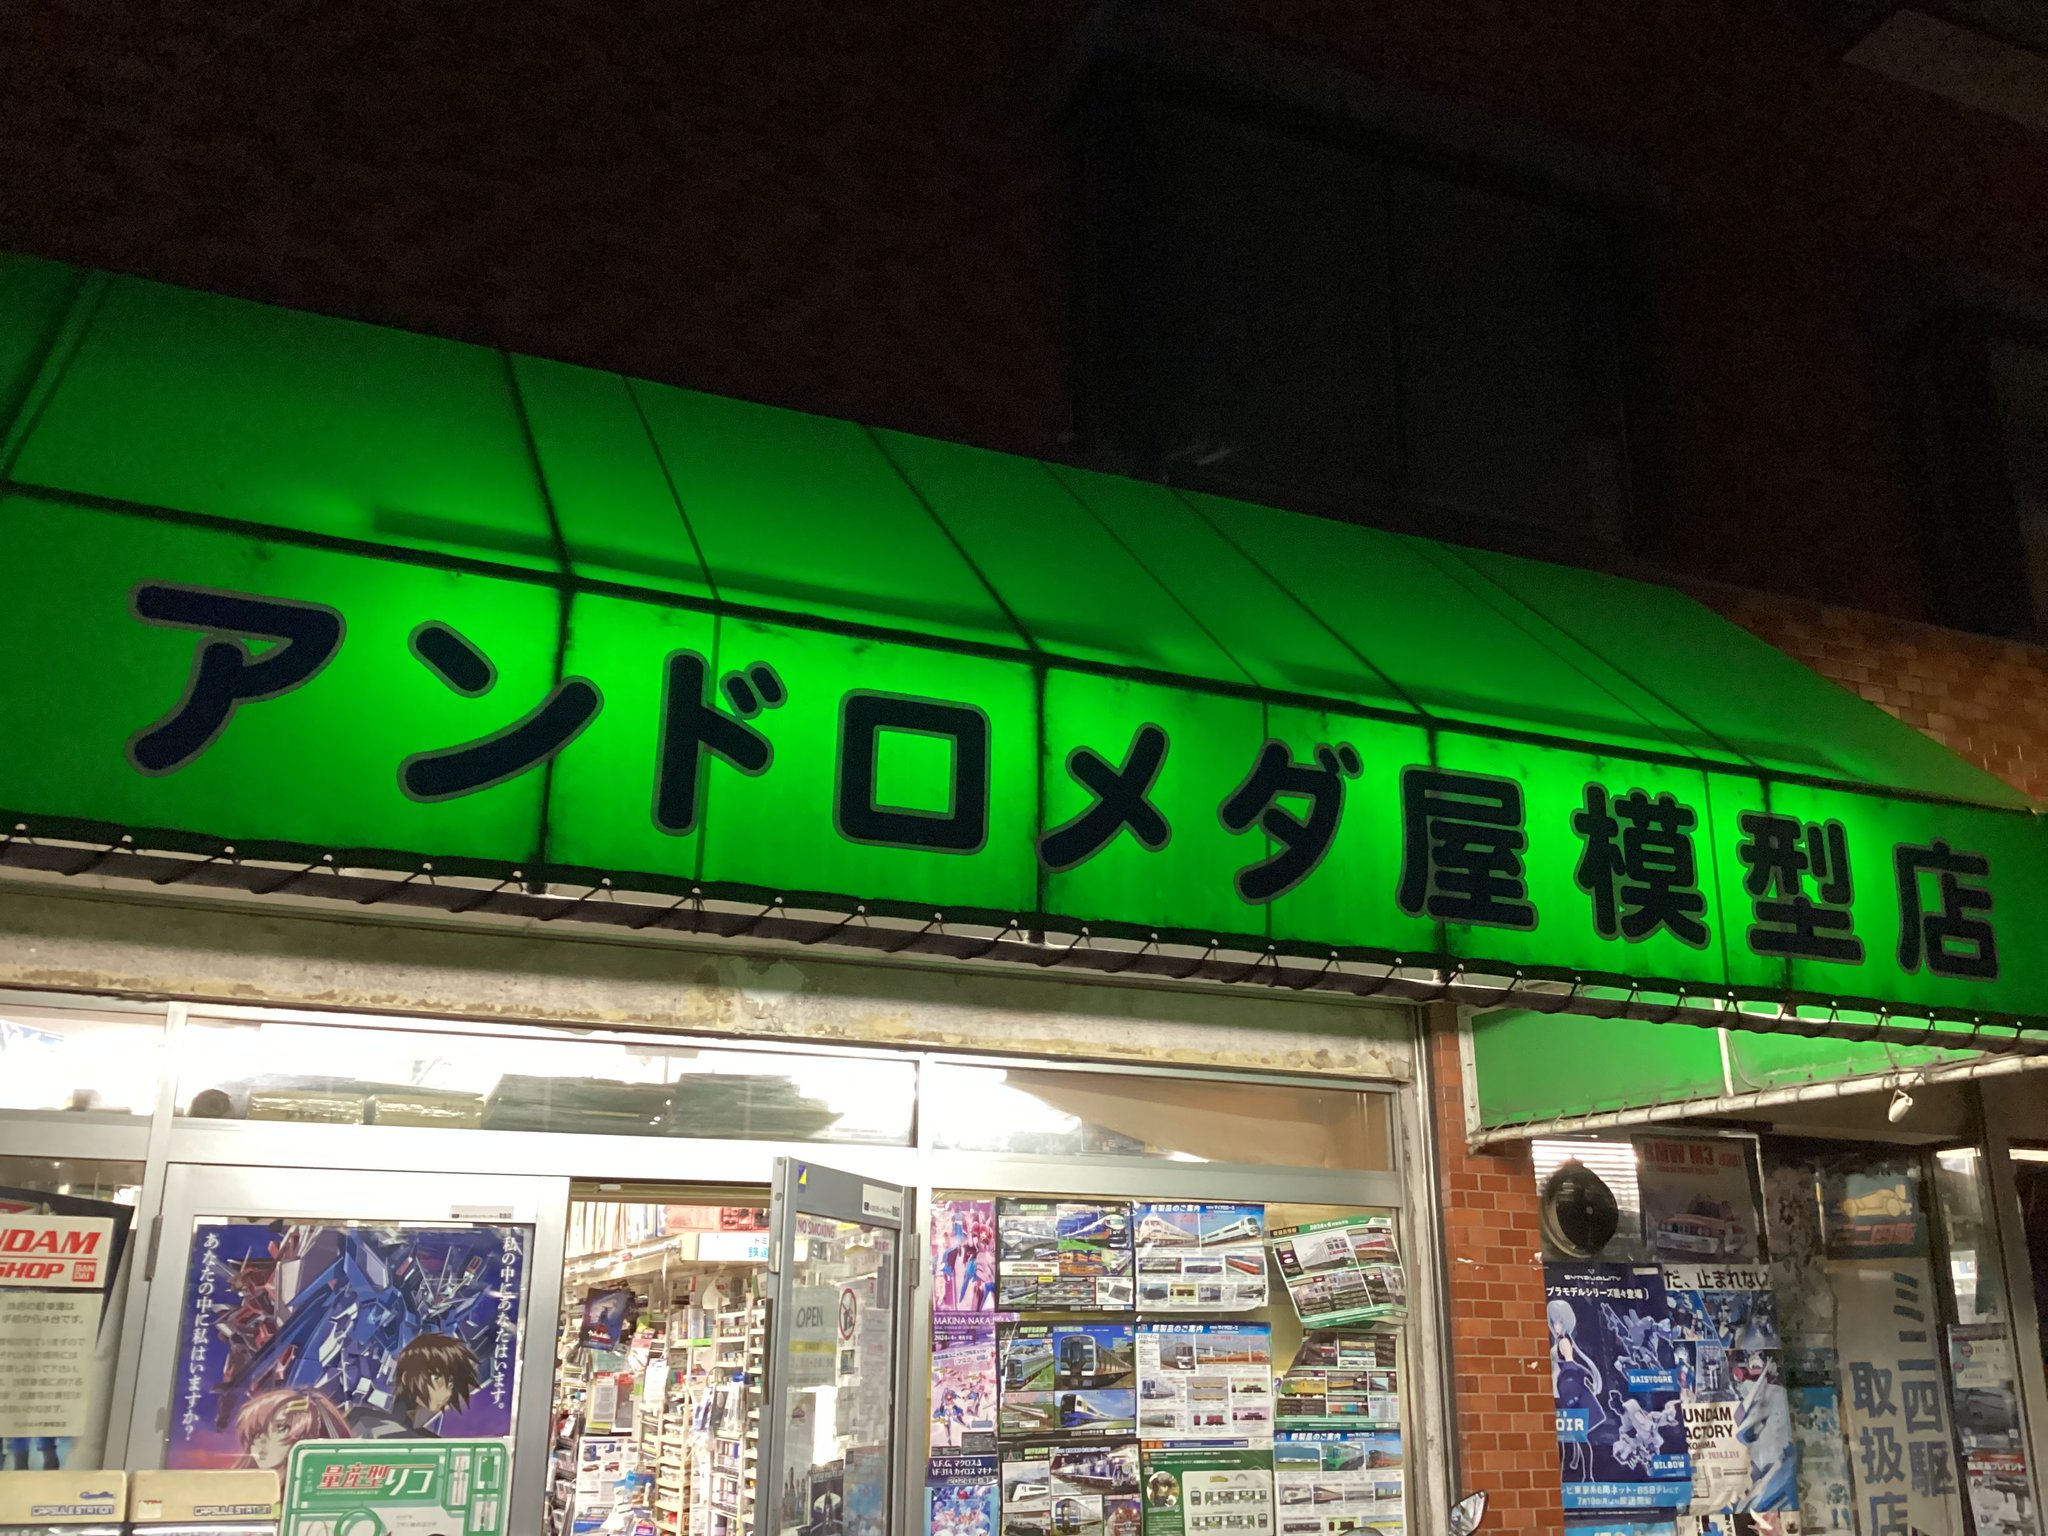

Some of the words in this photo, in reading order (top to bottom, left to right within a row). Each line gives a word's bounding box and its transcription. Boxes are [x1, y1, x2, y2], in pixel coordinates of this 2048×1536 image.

[125, 580, 2000, 981] アンドロメダ屋模型店
[796, 1305, 824, 1328] OPEN
[316, 1462, 436, 1496] 量産型リコ
